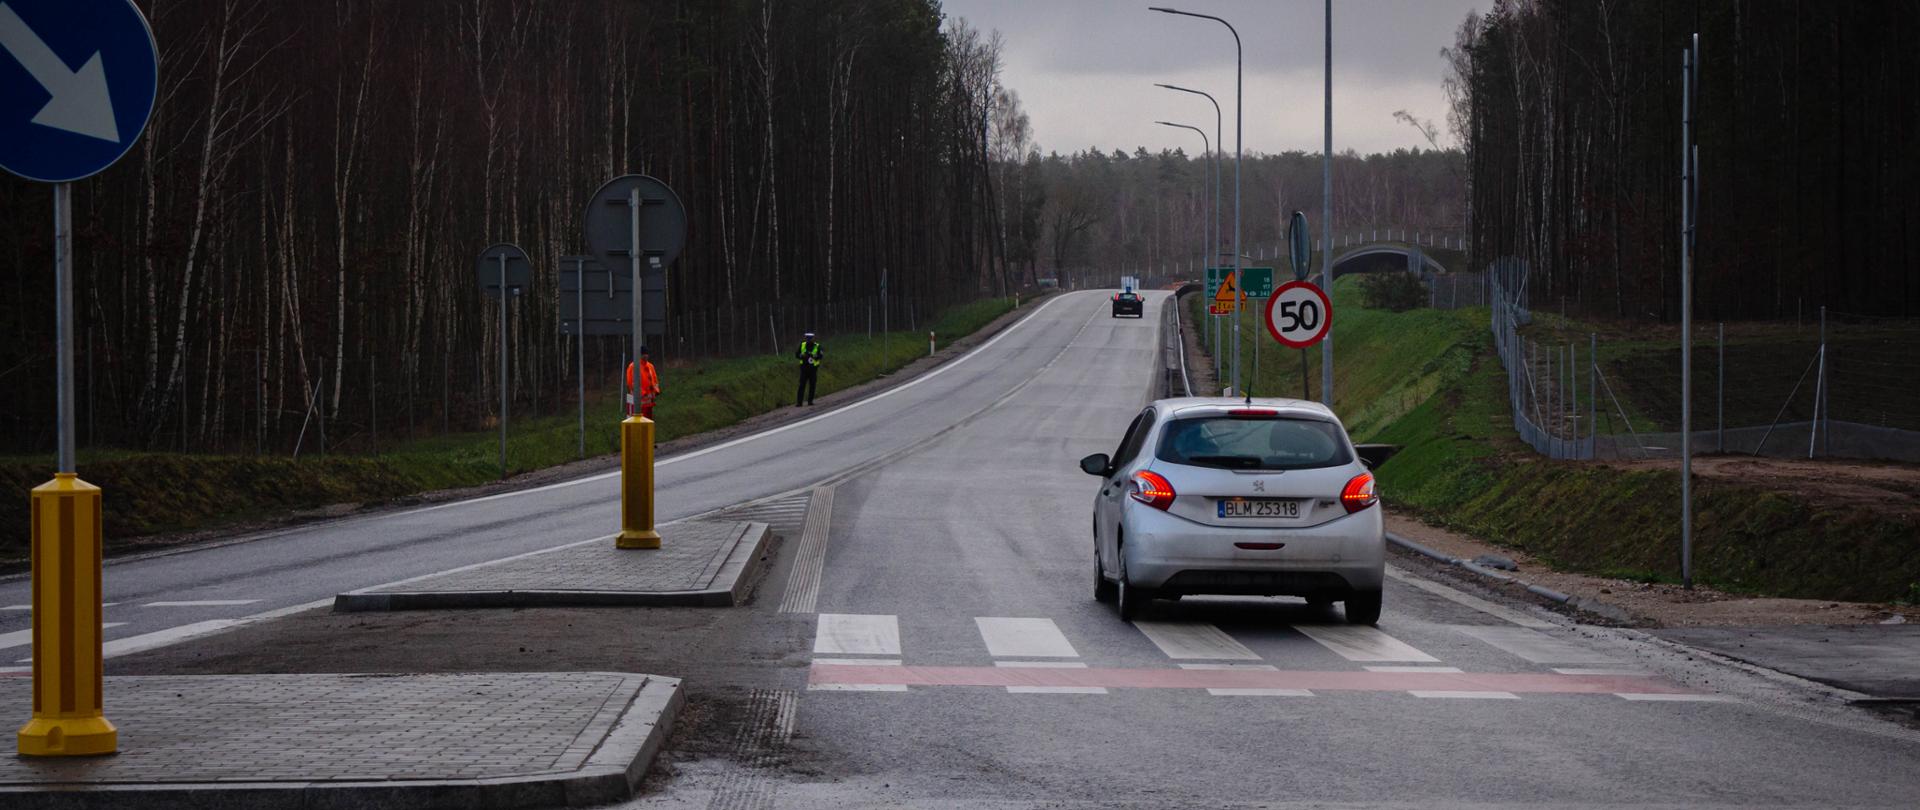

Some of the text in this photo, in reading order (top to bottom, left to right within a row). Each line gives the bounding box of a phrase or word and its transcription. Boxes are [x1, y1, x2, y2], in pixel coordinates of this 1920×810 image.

[1281, 300, 1318, 332] 50
[1226, 502, 1252, 515] BLM
[1256, 502, 1297, 516] 25318
